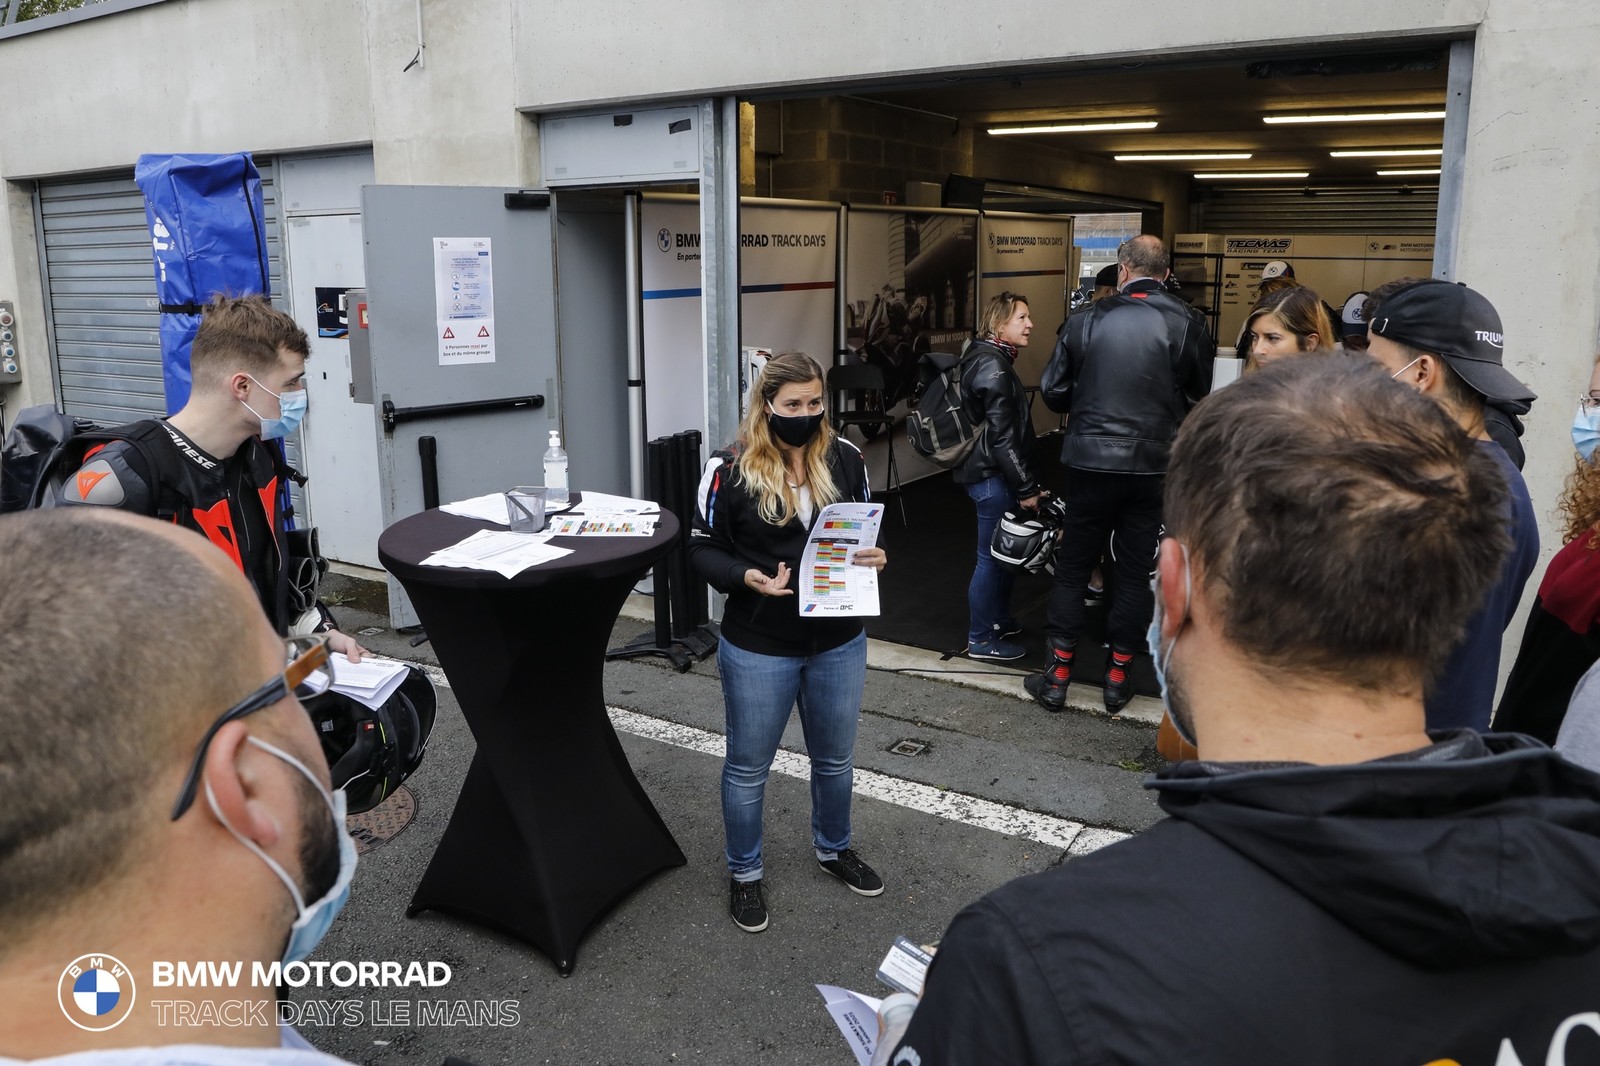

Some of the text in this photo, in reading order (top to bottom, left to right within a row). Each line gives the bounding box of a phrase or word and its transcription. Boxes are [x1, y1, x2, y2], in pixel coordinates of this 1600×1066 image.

[741, 233, 769, 248] RRAD
[772, 234, 802, 247] TRACK
[803, 234, 826, 247] DAYS
[996, 236, 1063, 246] BMW MOTORRAD TRACK DAYS
[1227, 239, 1291, 249] TECMAS
[677, 252, 684, 261] En
[930, 334, 946, 345] BMW
[1474, 330, 1505, 348] TRIUM
